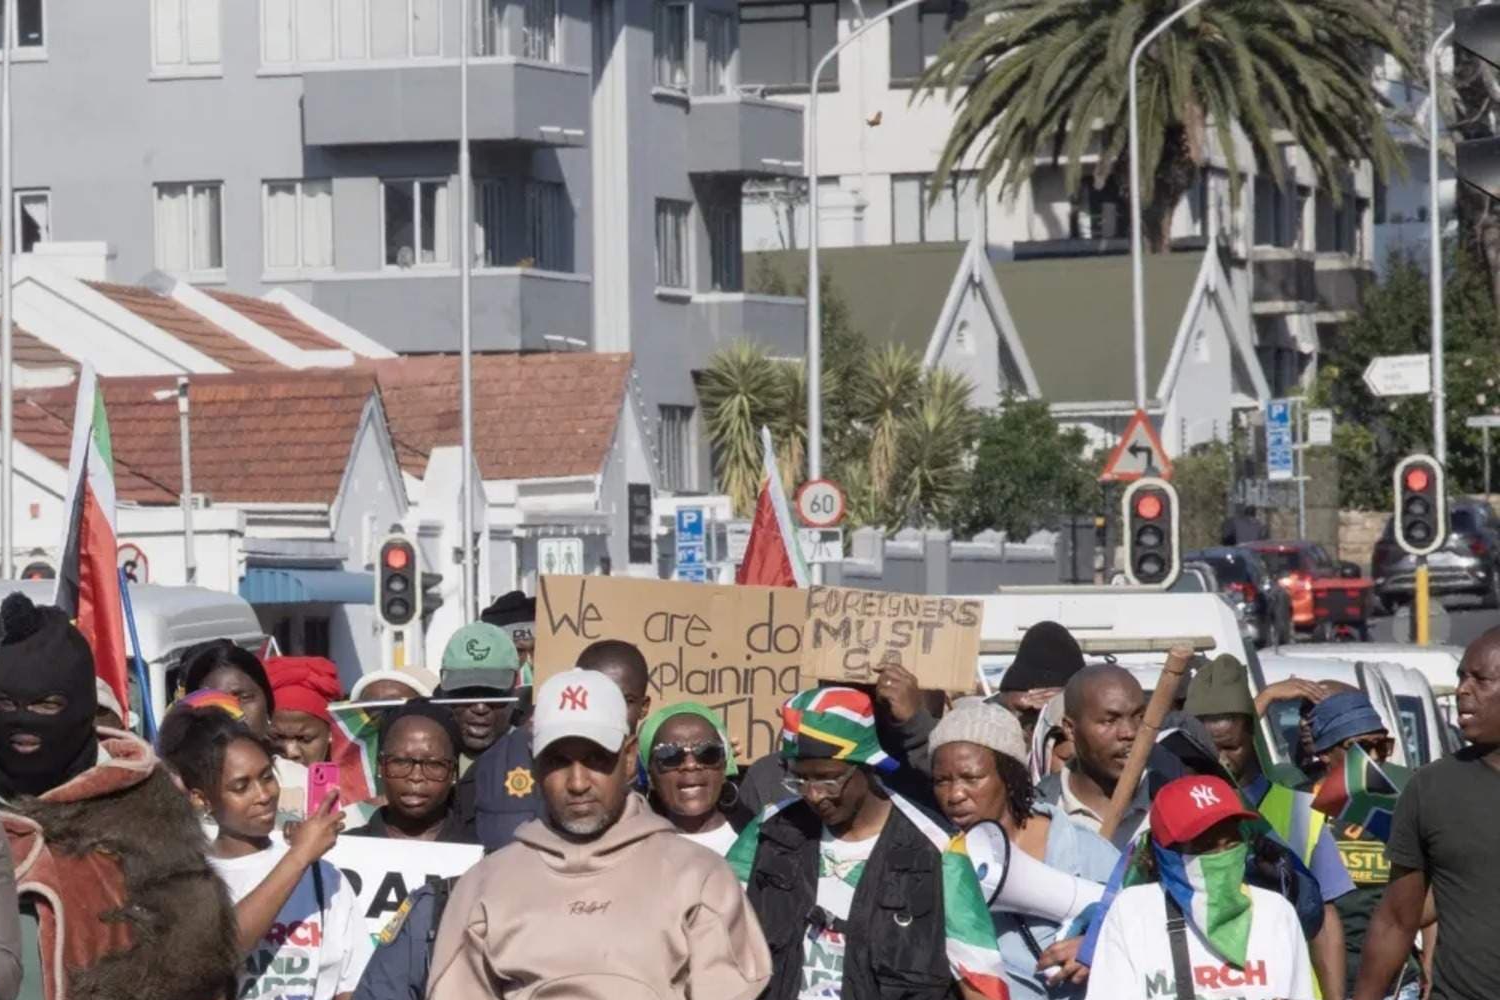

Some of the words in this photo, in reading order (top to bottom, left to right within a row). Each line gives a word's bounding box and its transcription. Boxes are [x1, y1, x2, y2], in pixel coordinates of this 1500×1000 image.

[809, 494, 835, 515] 60
[682, 512, 698, 529] P
[540, 575, 603, 640] We
[643, 610, 713, 647] are
[746, 591, 804, 654] do
[813, 615, 935, 655] MUST
[647, 645, 801, 701] xplaining
[558, 685, 589, 711] NY
[708, 696, 785, 759] Th
[1189, 783, 1222, 810] NY
[266, 920, 323, 948] RCH
